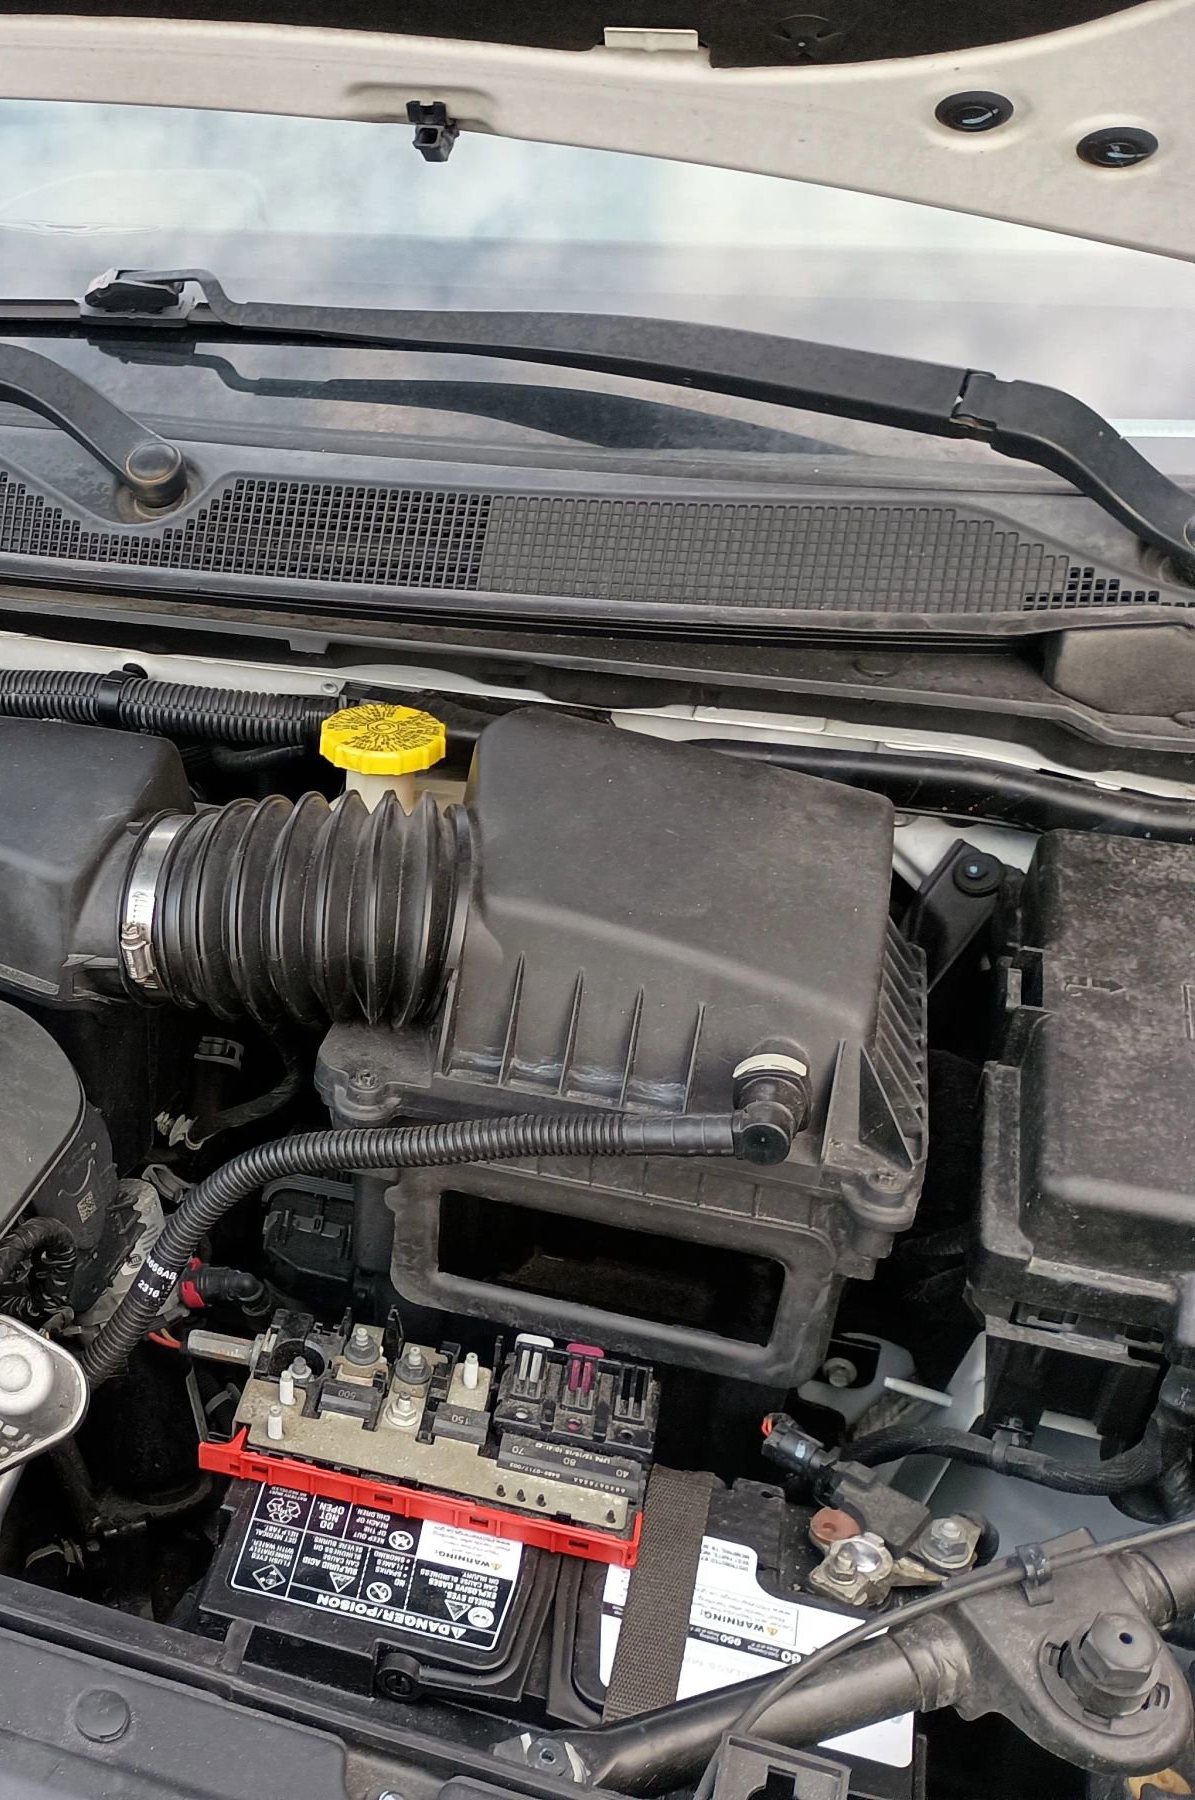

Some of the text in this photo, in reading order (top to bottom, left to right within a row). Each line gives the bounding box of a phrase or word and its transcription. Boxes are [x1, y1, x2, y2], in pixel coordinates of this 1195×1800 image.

[337, 1388, 356, 1399] 500
[450, 1413, 469, 1424] 150
[511, 1444, 629, 1478] 40 80 70
[315, 1500, 345, 1515] OPEN.
[318, 1511, 339, 1522] NOT
[355, 1515, 388, 1528] REACH OF
[319, 1519, 334, 1530] DO
[362, 1525, 386, 1536] OF THE
[254, 1528, 296, 1544] GET MEDICAL
[281, 1528, 298, 1537] HELP
[352, 1530, 385, 1544] KEEP OUT
[248, 1544, 292, 1560] IMMEDIATELY
[276, 1544, 294, 1554] WITH
[324, 1545, 361, 1560] BLINDNESS
[337, 1541, 363, 1553] SEVERE
[268, 1556, 290, 1566] FLUSH
[322, 1553, 359, 1567] CAN CAUSE
[373, 1550, 405, 1562] SMOKING
[434, 1549, 490, 1567] WARNING:
[301, 1555, 358, 1575] SULFURIC ACID
[393, 1578, 405, 1587] NO
[419, 1568, 497, 1592] CAN CAUSE BLINDNESS
[427, 1576, 496, 1599] EXPLOSIVE GASES
[466, 1595, 495, 1608] SHIELD
[316, 1594, 451, 1636] DANGER/POISON
[699, 1609, 765, 1632] WARNING:
[719, 1633, 742, 1646] 950
